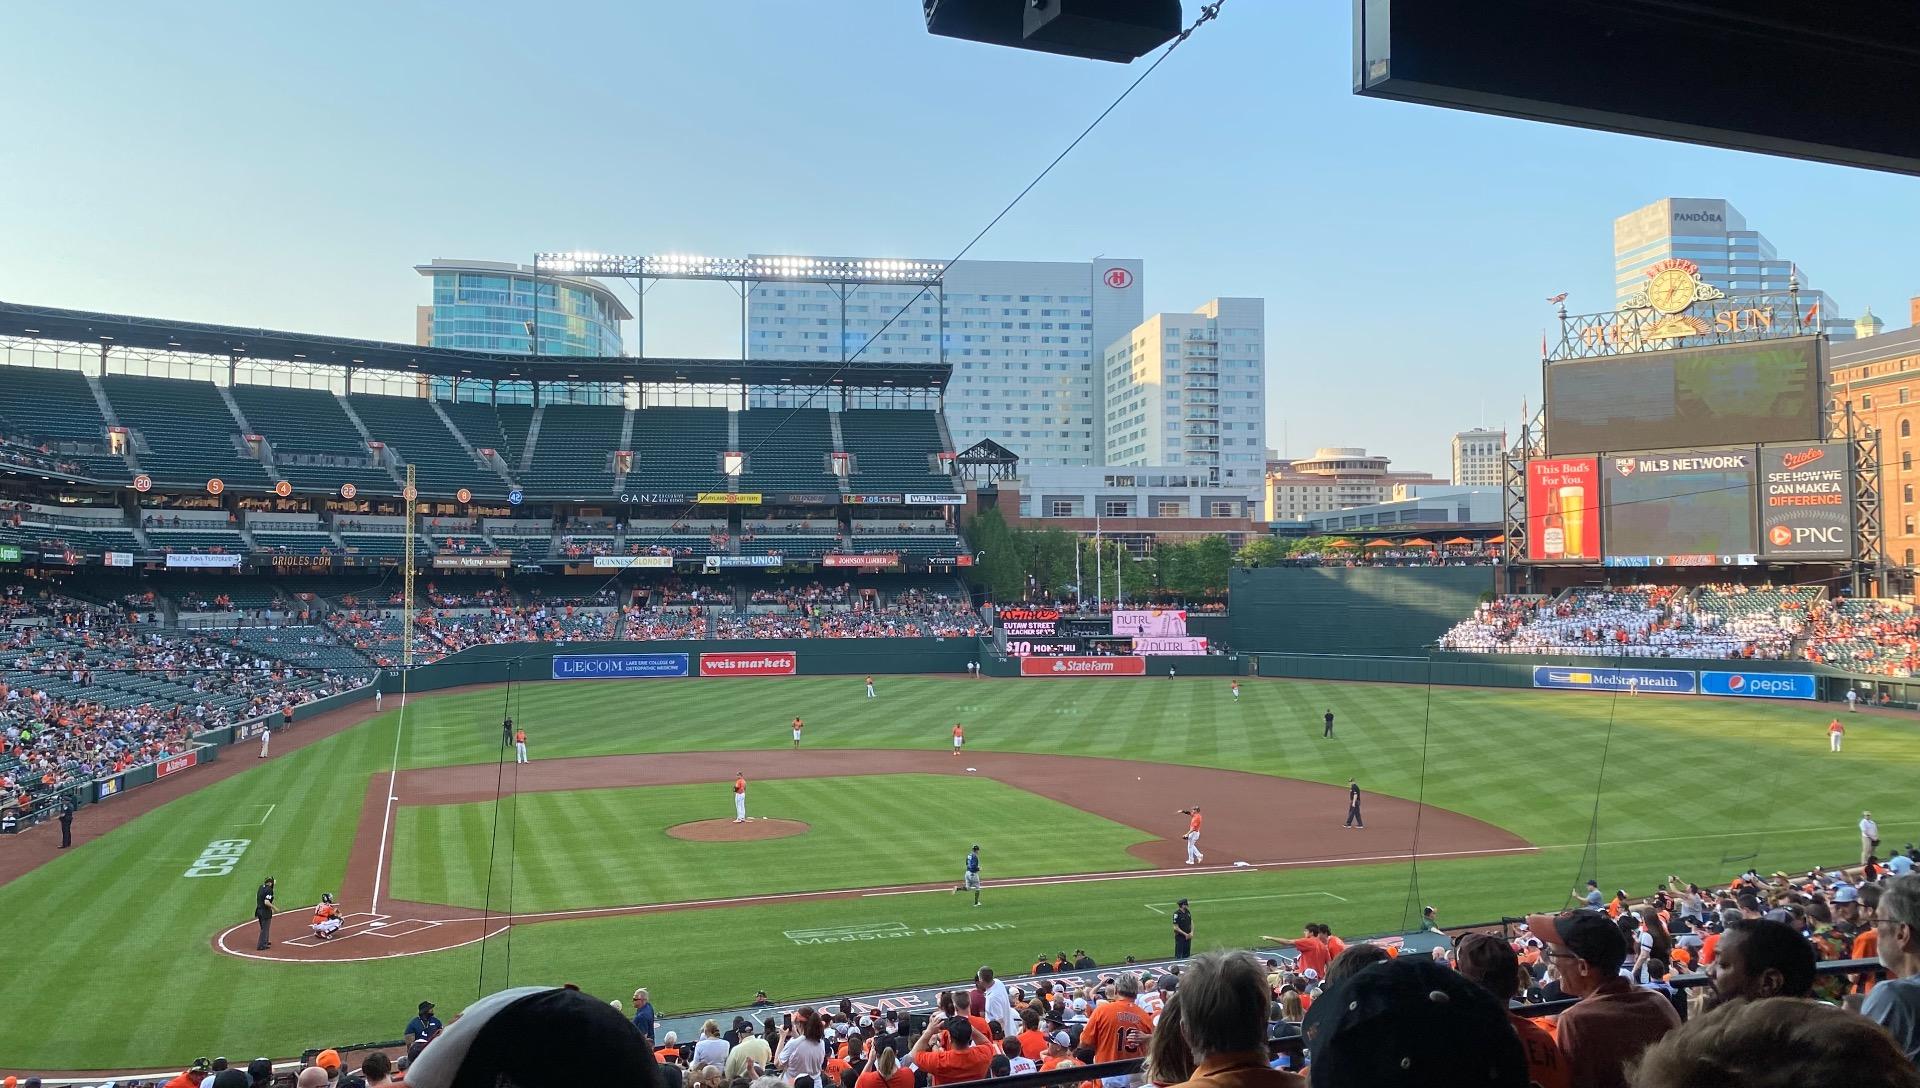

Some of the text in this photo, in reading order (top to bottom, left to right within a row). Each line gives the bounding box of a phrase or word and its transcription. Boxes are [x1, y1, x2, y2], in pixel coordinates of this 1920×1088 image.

[1715, 307, 1773, 333] SUN
[1640, 456, 1745, 473] MLB NETWORK
[1783, 448, 1825, 470] Orioles
[1536, 463, 1590, 475] This Bud's
[1542, 475, 1584, 485] For You.
[1769, 470, 1842, 483] SEE HOW WE
[137, 480, 149, 488] 20
[1770, 483, 1841, 495] CAN MAKE A
[343, 486, 354, 495] 22
[511, 493, 520, 501] 42
[620, 494, 658, 503] GANZ
[1769, 494, 1842, 507] DIFFERENCE
[1793, 527, 1844, 543] PNC
[272, 556, 331, 566] ORIOLES.COM
[595, 557, 632, 566] GUINNESS
[751, 555, 781, 564] UNION
[838, 557, 865, 565] JOHNSON
[1656, 557, 1664, 565] 0
[1724, 556, 1731, 565] 0
[1006, 641, 1031, 656] $10
[705, 657, 792, 669] weis markets
[1593, 674, 1678, 687] MedSta Health
[1749, 678, 1794, 693] pepsi
[184, 838, 252, 878] GEICO
[793, 921, 1018, 946] MedStar Health
[817, 994, 929, 1018] OME
